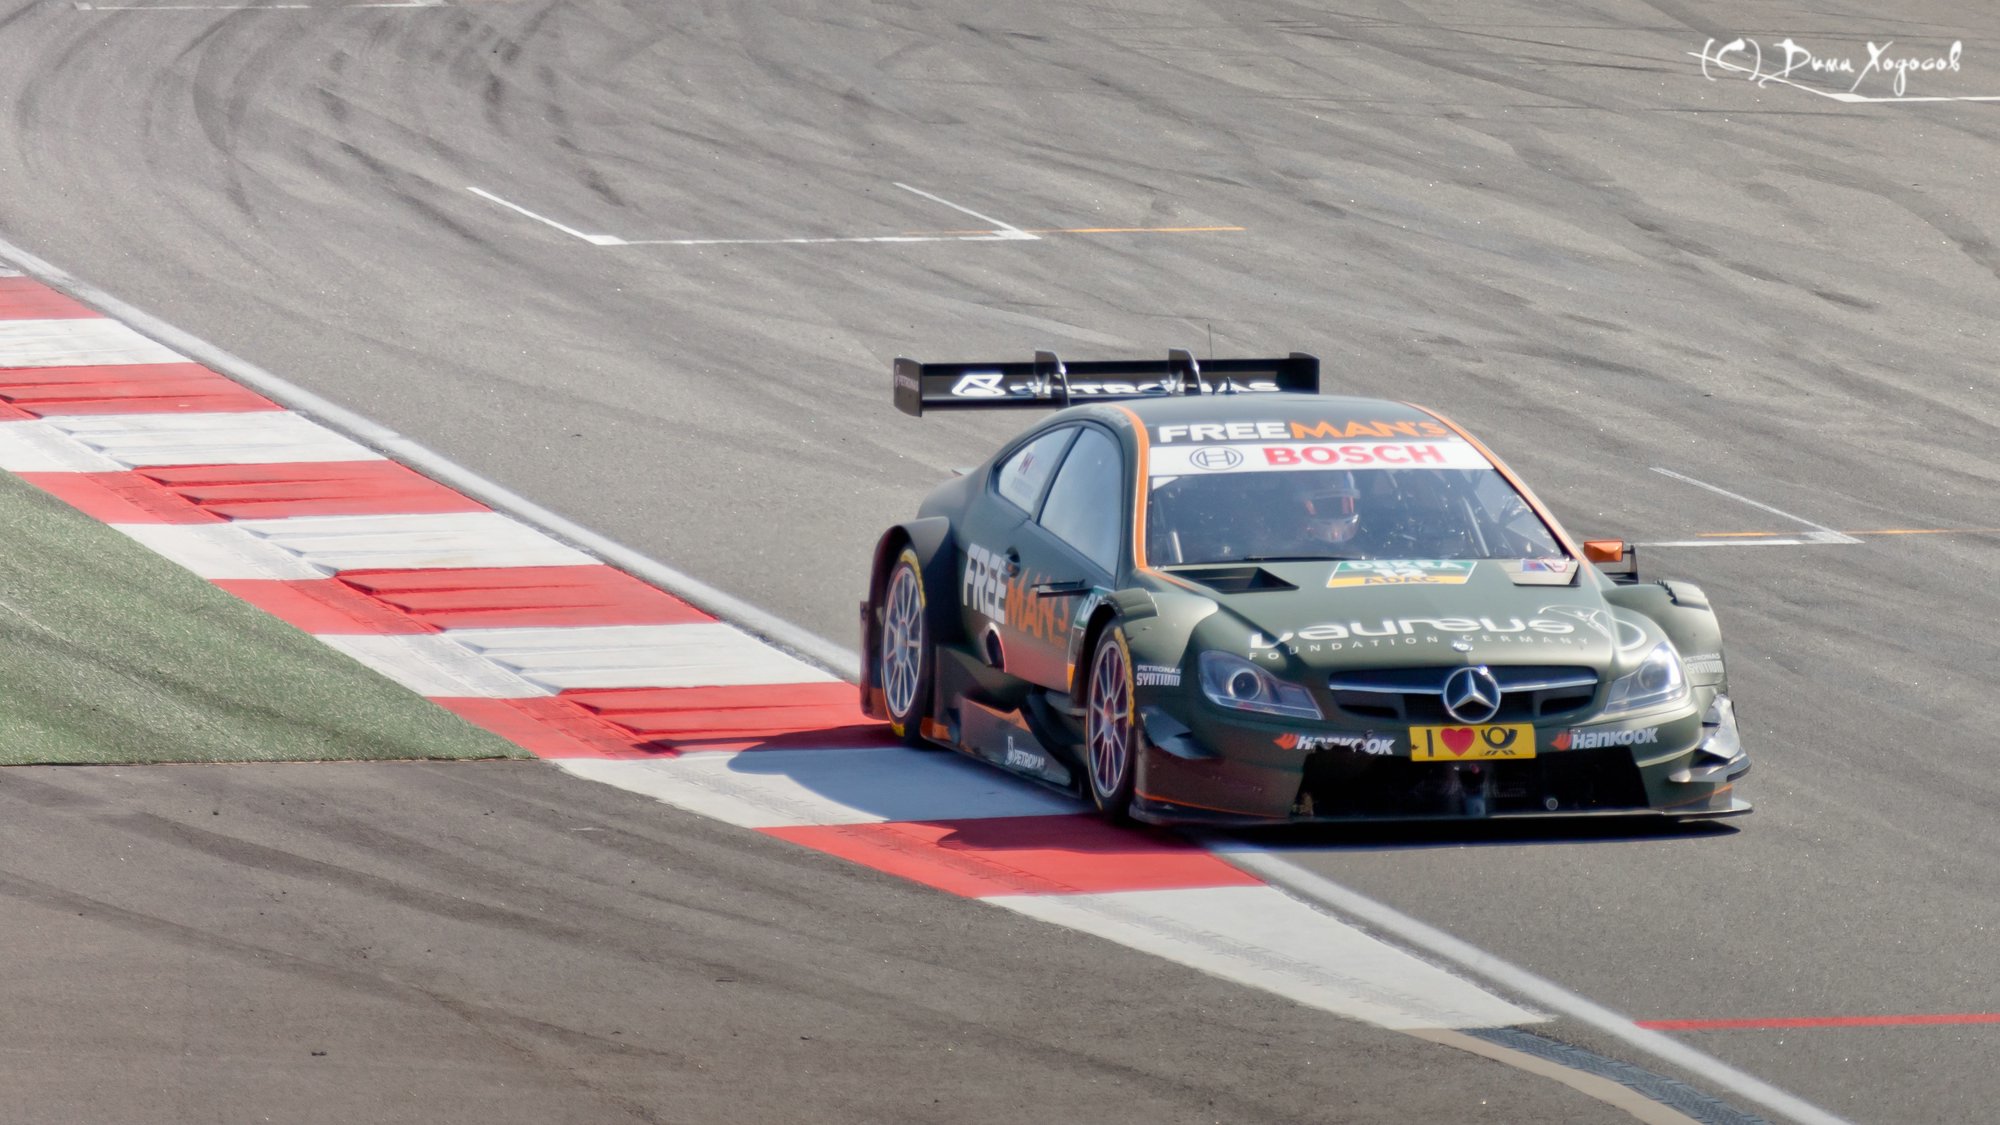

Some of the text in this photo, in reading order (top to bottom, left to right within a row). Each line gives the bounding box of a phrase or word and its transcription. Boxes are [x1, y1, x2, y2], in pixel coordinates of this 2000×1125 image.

[1158, 421, 1449, 443] FREEMAN'S
[1262, 445, 1448, 466] BOSCH
[1248, 634, 1588, 660] FOUNDATION GERMANY
[1137, 664, 1181, 674] PETRONAS
